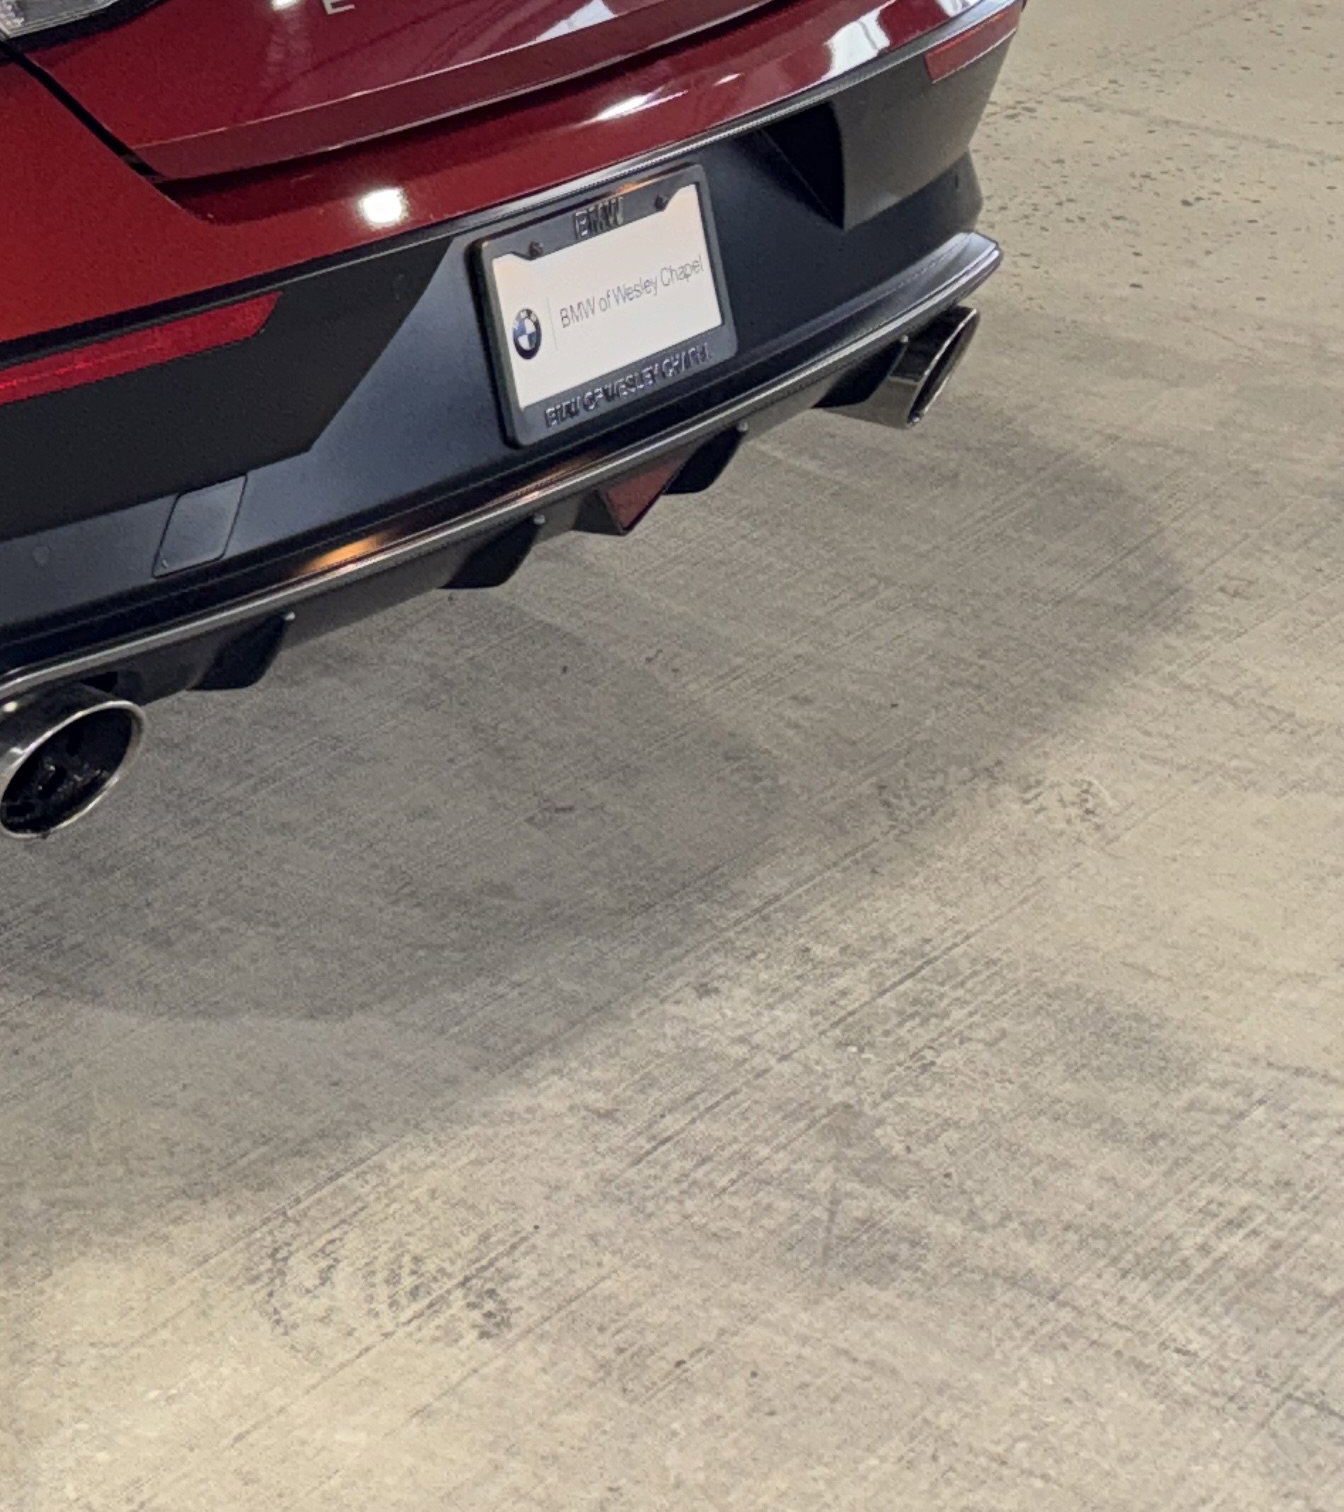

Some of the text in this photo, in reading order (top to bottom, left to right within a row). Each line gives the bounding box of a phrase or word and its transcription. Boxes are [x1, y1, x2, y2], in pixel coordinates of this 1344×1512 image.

[575, 196, 624, 240] BMW
[559, 254, 705, 328] BMW of Wesley Chapel
